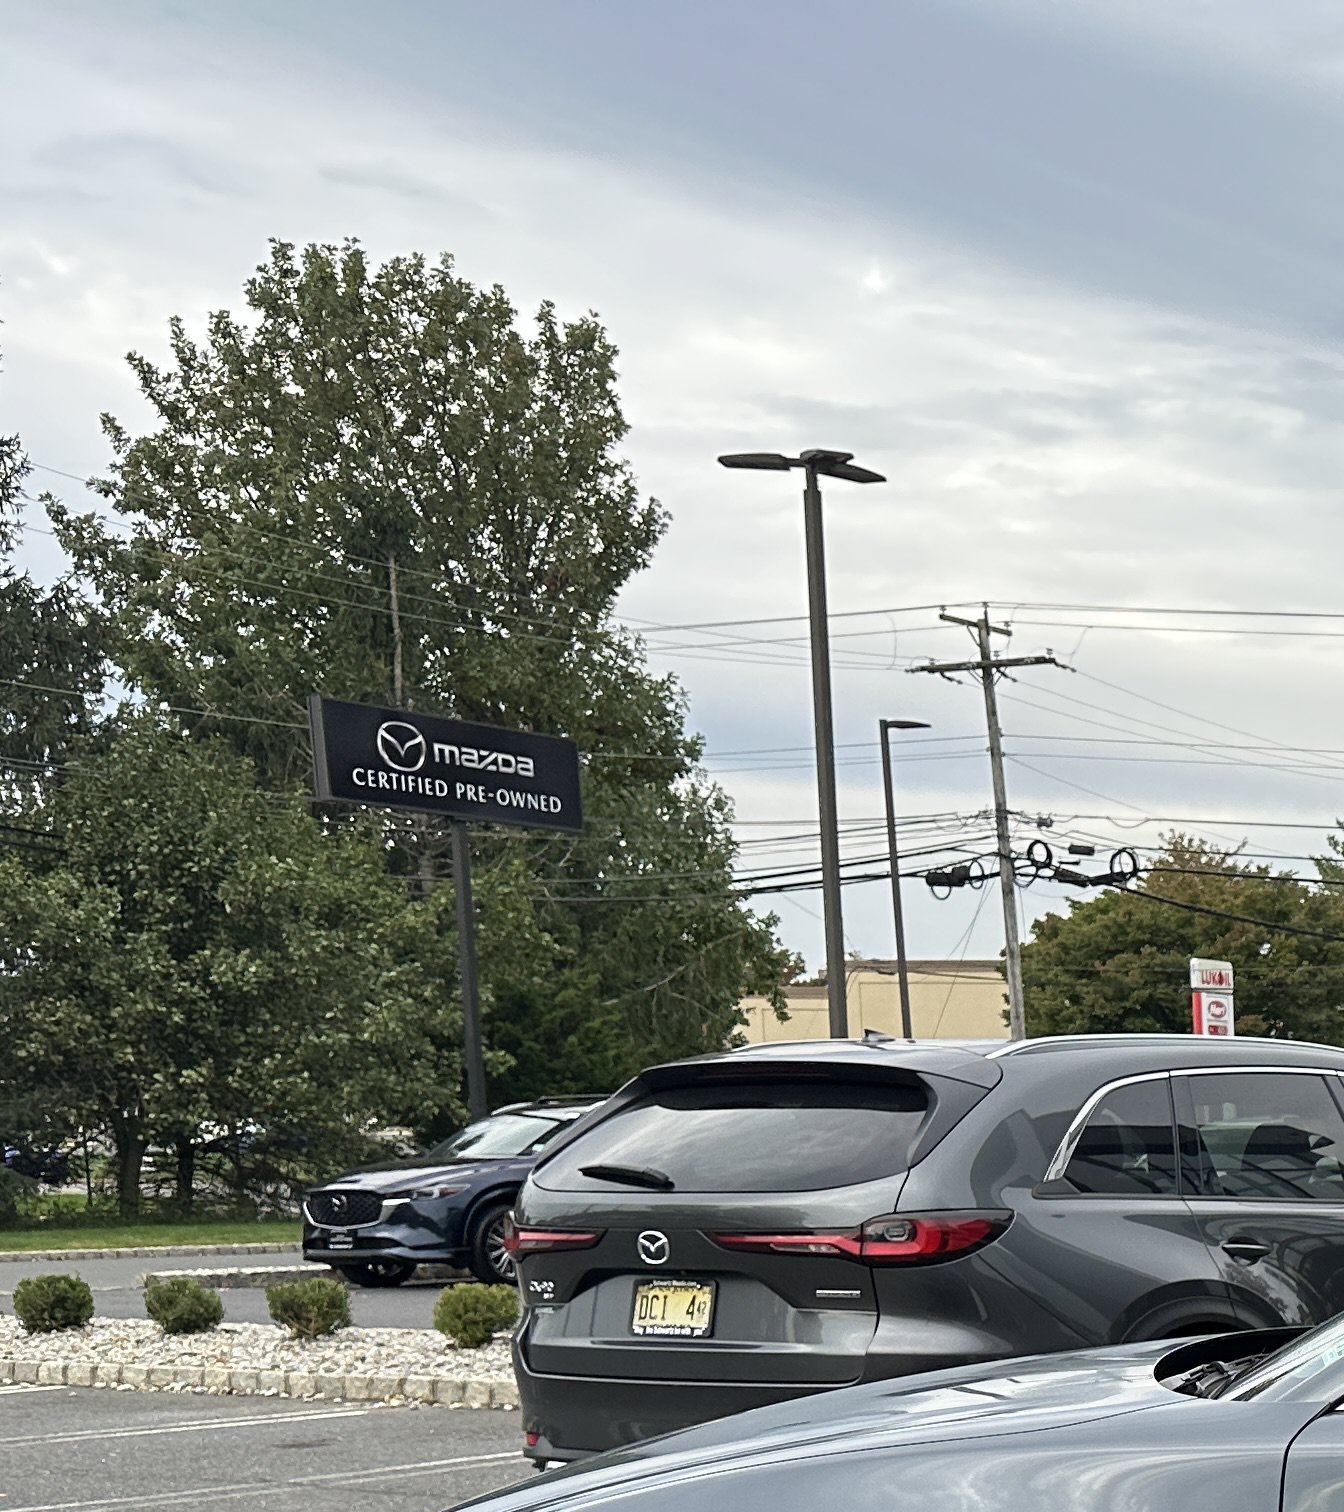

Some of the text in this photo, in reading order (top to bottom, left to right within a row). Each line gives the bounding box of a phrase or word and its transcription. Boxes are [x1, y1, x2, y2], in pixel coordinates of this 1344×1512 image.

[352, 767, 562, 813] CERTIFIED PRE-OWNED
[638, 1294, 668, 1321] DCI
